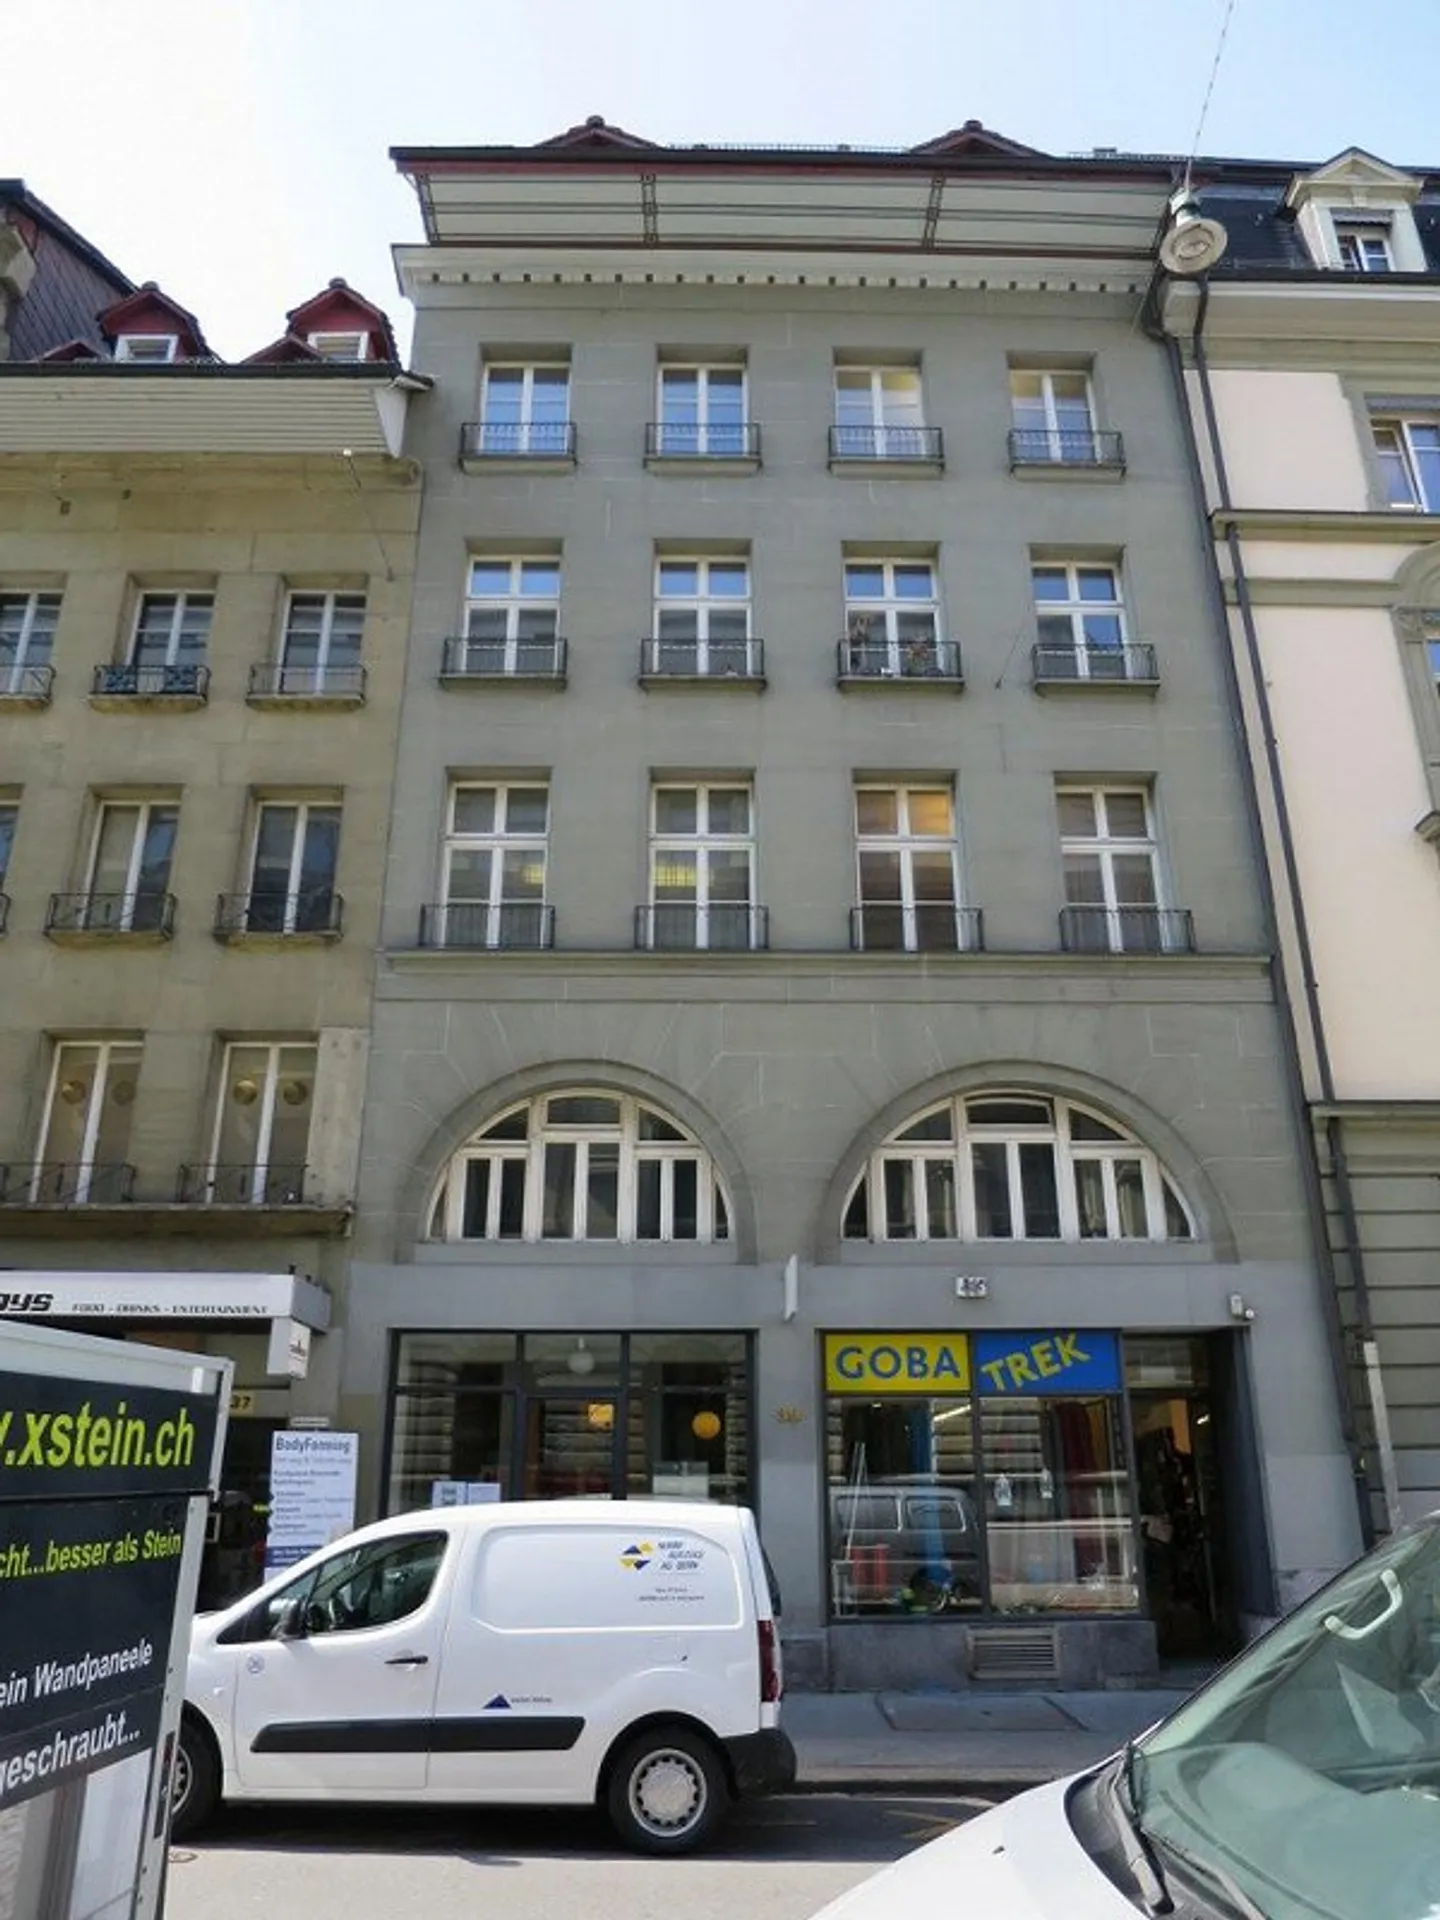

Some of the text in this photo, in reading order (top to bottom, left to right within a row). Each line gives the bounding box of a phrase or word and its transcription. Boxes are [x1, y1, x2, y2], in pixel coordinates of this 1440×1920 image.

[835, 1333, 1091, 1392] GOBA TREK
[113, 1531, 139, 1564] als
[142, 1528, 182, 1560] Stein
[33, 1637, 153, 1699] Wandpaneele
